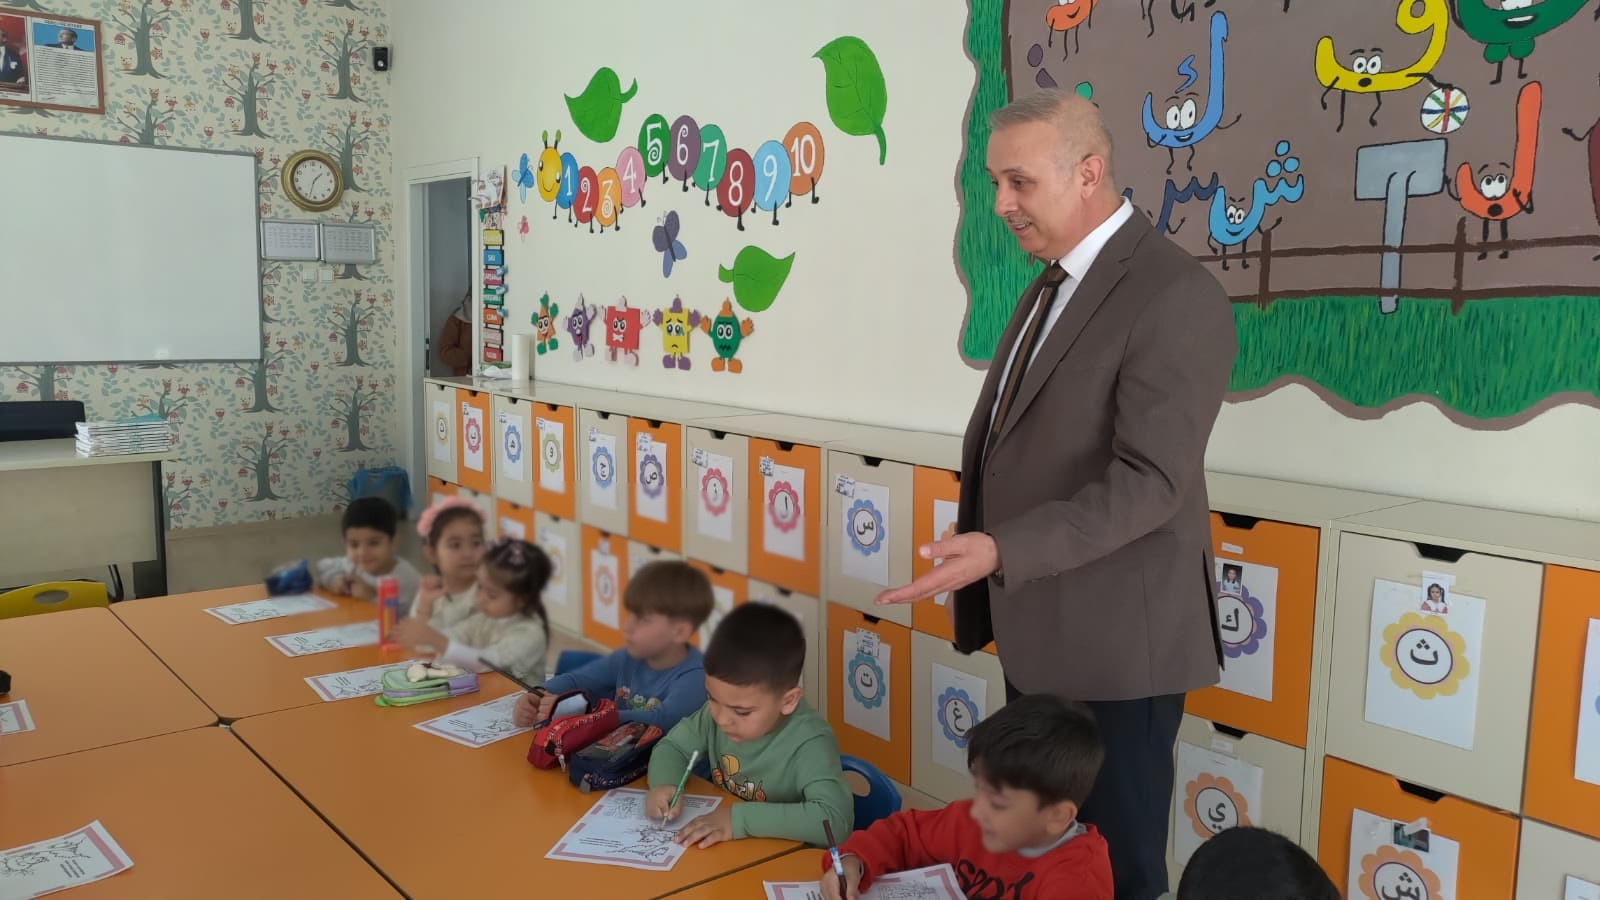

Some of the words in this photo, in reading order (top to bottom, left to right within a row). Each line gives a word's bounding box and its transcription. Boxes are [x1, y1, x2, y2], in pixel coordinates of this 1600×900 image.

[564, 159, 573, 197] 1
[581, 177, 592, 213] 2
[601, 180, 613, 219] 3
[623, 156, 637, 194] 4
[646, 122, 663, 166] 5
[676, 124, 689, 165] 6
[702, 140, 720, 183] 7
[728, 160, 744, 207] 8
[762, 154, 778, 202] 9
[790, 134, 817, 177] 10
[1209, 140, 1304, 246] ش
[856, 521, 874, 536] س
[1221, 608, 1240, 632] ك
[1410, 638, 1439, 666] ث
[860, 672, 873, 688] ت
[1207, 802, 1226, 831] ي
